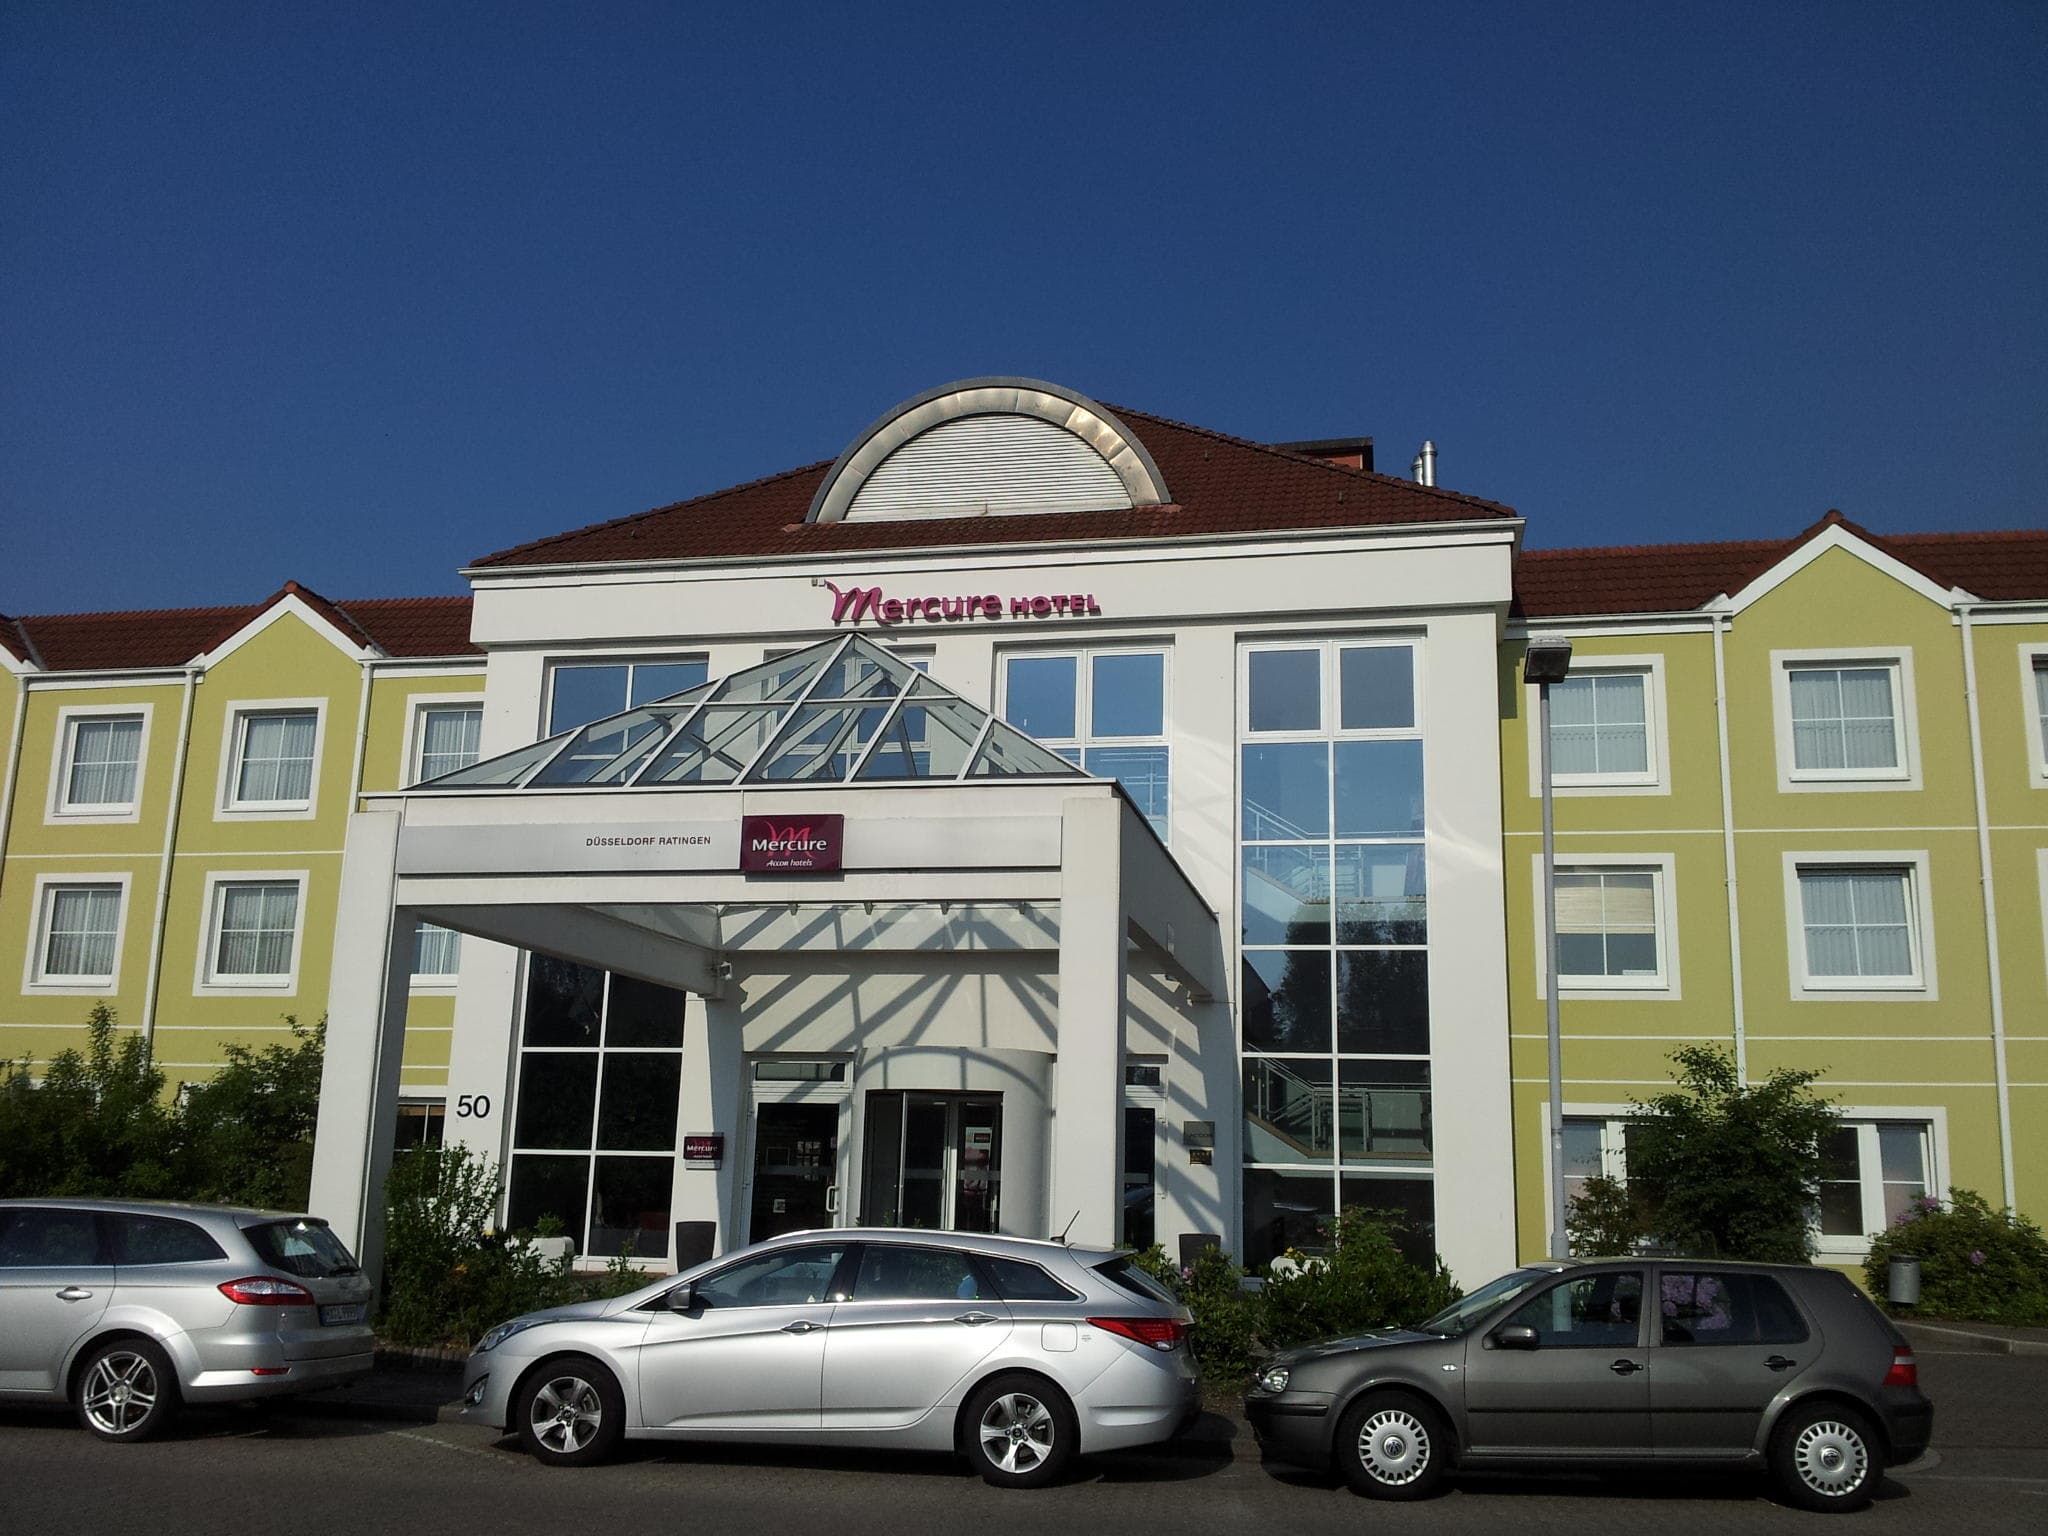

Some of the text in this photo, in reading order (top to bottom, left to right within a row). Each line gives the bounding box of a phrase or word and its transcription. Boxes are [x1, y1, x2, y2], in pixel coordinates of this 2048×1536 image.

[826, 580, 1101, 625] Mercure HOTEL
[586, 836, 711, 846] DÜSSELDORF RATINGEN
[752, 839, 827, 851] Mercure
[456, 1094, 491, 1118] 50
[687, 1144, 718, 1152] Mercure
